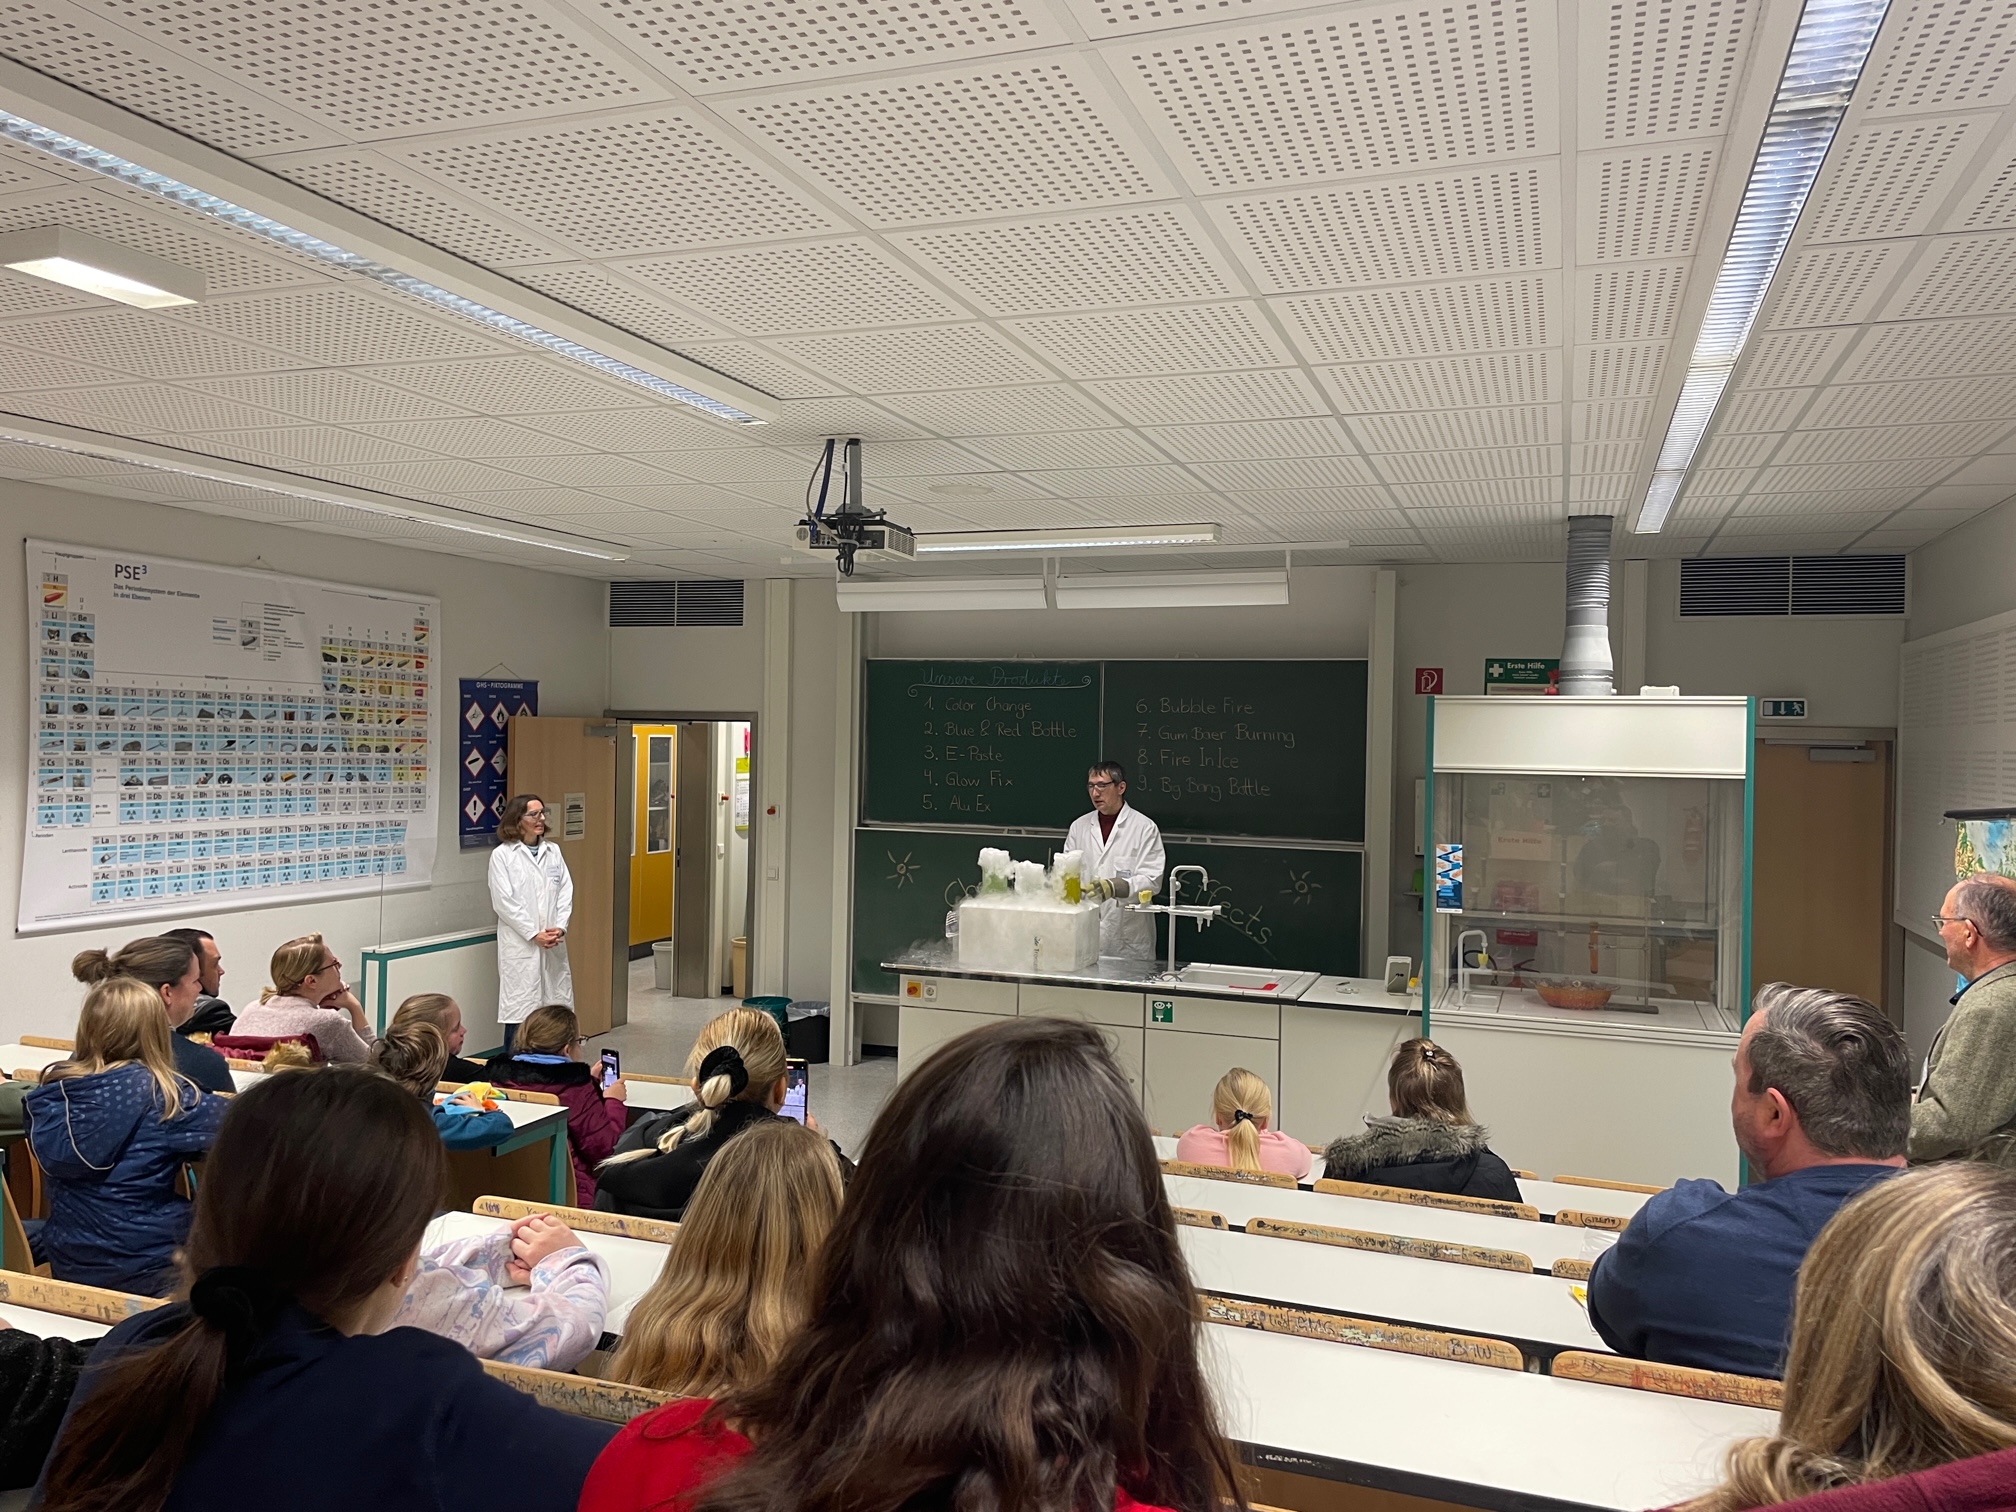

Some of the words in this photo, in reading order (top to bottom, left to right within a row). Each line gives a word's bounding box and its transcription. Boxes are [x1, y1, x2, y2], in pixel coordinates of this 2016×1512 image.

[1528, 662, 1545, 670] Hilfe
[921, 667, 979, 685] Unsere
[987, 666, 1071, 686] Produkte
[924, 697, 934, 711] 1.
[945, 697, 976, 711] Color
[986, 696, 1032, 719] Change
[1136, 699, 1151, 714] 6.
[1160, 697, 1216, 714] Bubble
[1223, 697, 1255, 715] Fire
[924, 722, 938, 736] 2.
[945, 722, 975, 736] Blue
[980, 720, 991, 736] &
[997, 722, 1021, 736] Red
[1032, 721, 1077, 738] Bottle
[1137, 723, 1151, 740] 7.
[1158, 726, 1188, 741] Gum
[1191, 727, 1227, 741] Baer
[1235, 723, 1295, 749] Burning
[924, 746, 939, 761] 3.
[946, 746, 1004, 762] E-Paste
[1137, 749, 1152, 766] 8.
[1160, 749, 1191, 767] Fire
[1200, 747, 1214, 767] In
[1217, 747, 1239, 769] Ice
[924, 770, 938, 786] 4.
[946, 771, 980, 787] Glow
[990, 770, 1013, 787] Fix
[1137, 775, 1152, 792] 9.
[1160, 777, 1181, 800] Big
[1187, 777, 1221, 802] Bang
[1229, 777, 1271, 797] Bottle
[922, 794, 937, 810] 5.
[949, 794, 970, 812] Alu
[976, 794, 991, 812] Ex
